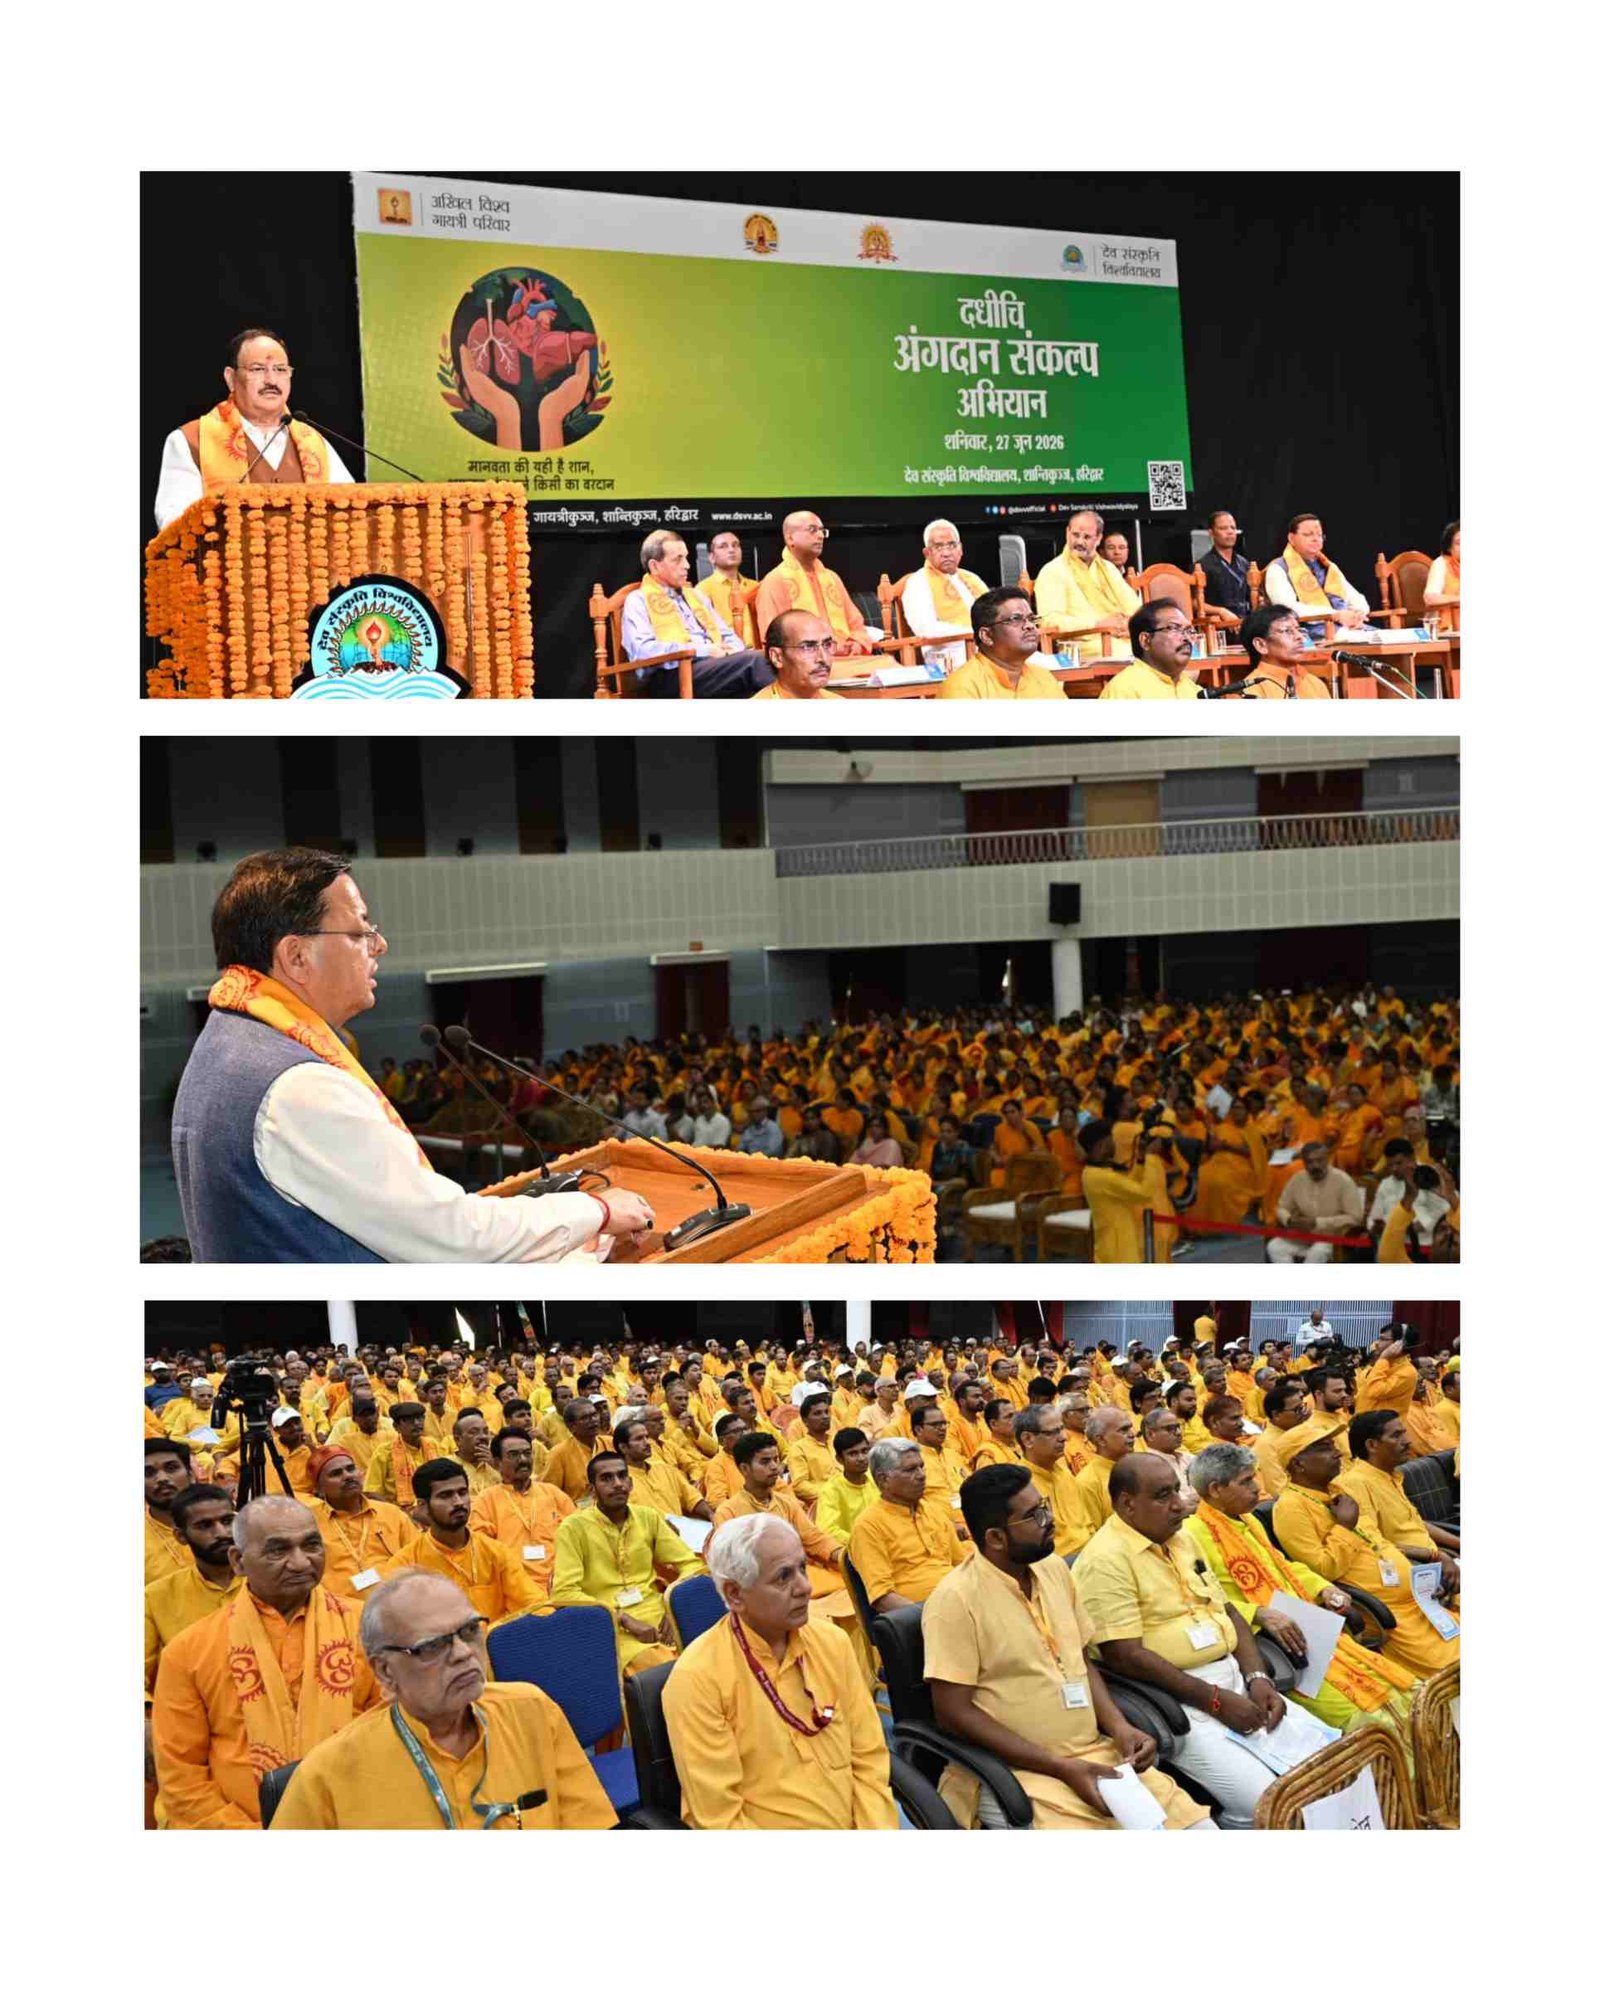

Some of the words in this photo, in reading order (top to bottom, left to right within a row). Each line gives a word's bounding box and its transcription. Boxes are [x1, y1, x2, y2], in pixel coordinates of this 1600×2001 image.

[431, 192, 472, 210] अखिल
[479, 195, 510, 213] विश्व
[432, 212, 467, 229] गायत्री
[473, 214, 511, 232] परिवार
[1101, 243, 1117, 259] देव
[957, 289, 1025, 330] दधीचि
[894, 325, 1000, 375] अंगदान
[1007, 330, 1099, 377] संकल्प
[956, 378, 1048, 418] अभियान
[944, 429, 993, 453] शनिवार,
[996, 434, 1010, 450] 27
[1012, 434, 1032, 455] जून
[1035, 434, 1065, 450] 2026
[468, 460, 511, 474] मानवता
[514, 458, 530, 474] की
[534, 457, 553, 474] यही
[557, 456, 565, 474] है
[569, 460, 595, 475] शान,
[904, 466, 919, 483] देव
[534, 474, 561, 491] किसी
[565, 478, 580, 491] का
[583, 478, 615, 491] वरदान
[664, 505, 700, 522] हरिद्वार
[711, 511, 773, 520] www.dsvv.ac.in
[317, 630, 329, 650] देव
[328, 590, 368, 625] संस्कृति
